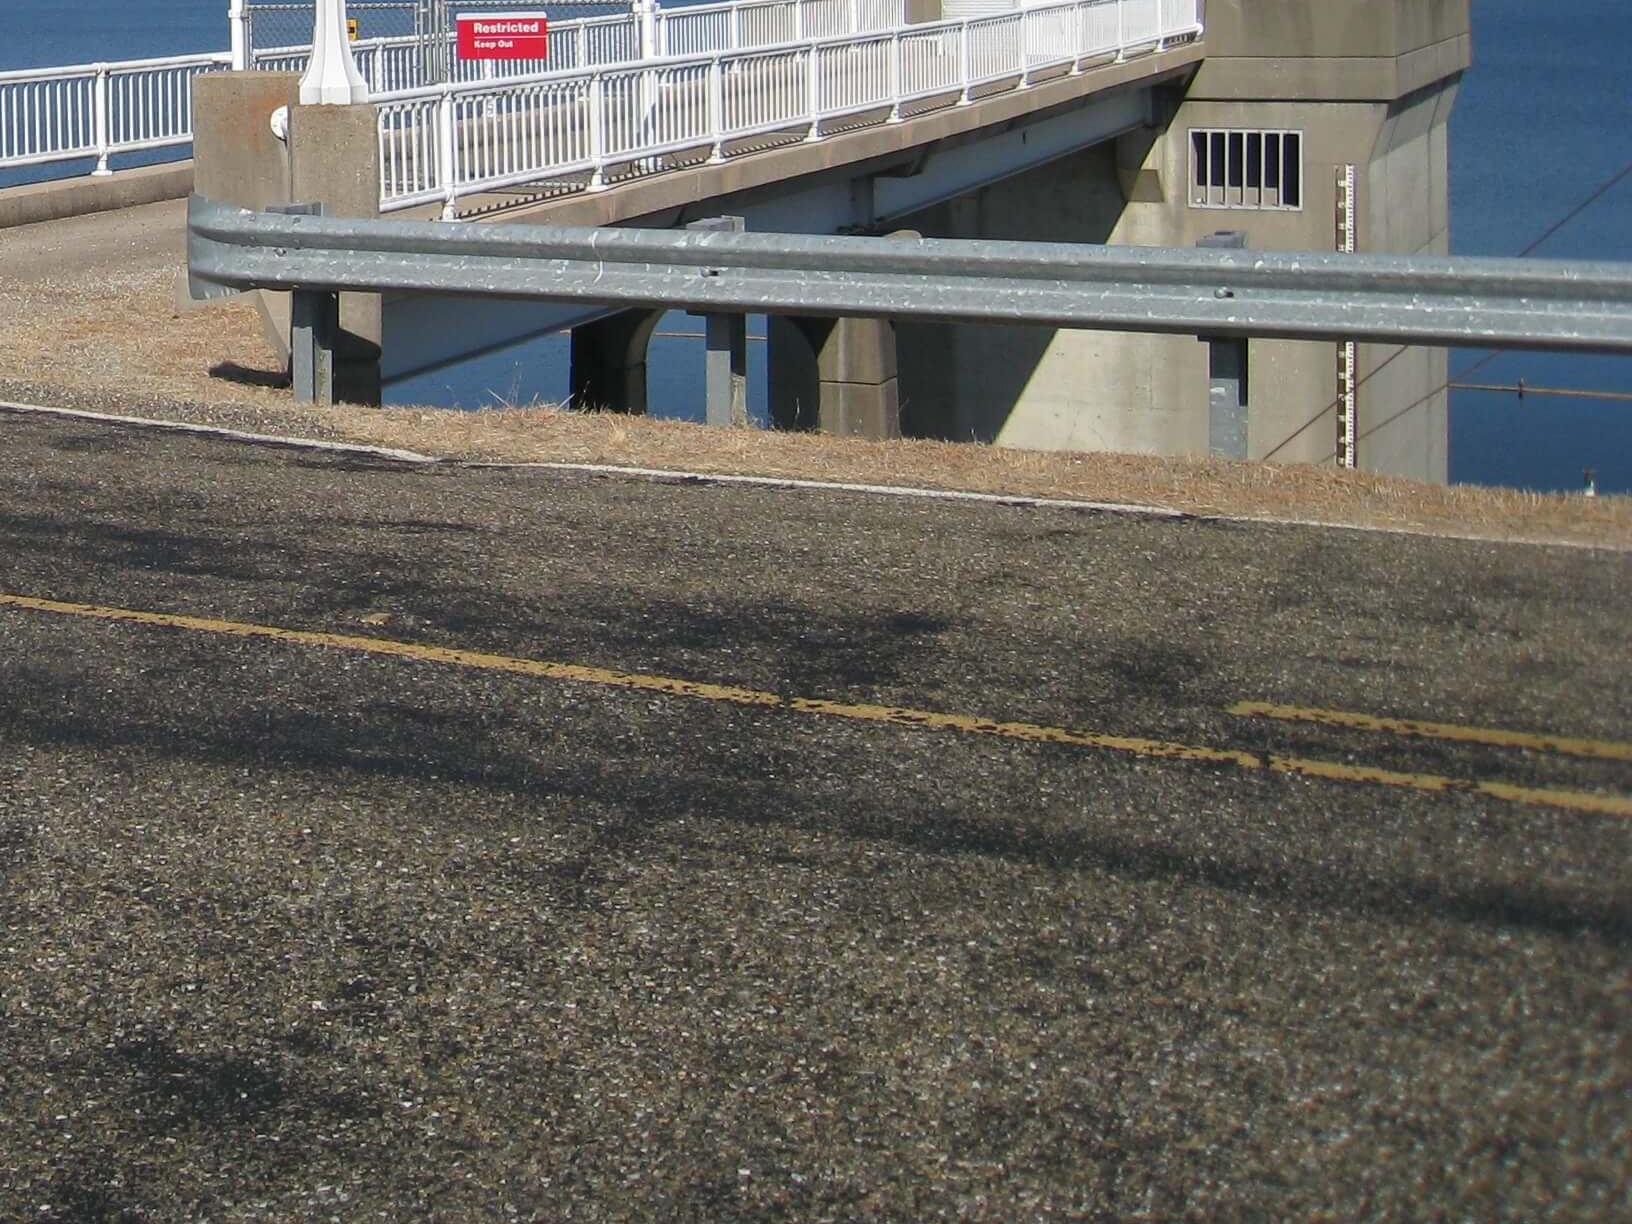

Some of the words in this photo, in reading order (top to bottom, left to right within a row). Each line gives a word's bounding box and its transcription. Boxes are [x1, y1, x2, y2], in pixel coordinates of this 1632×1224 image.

[473, 21, 539, 33] Restricted
[473, 39, 496, 49] Keep
[497, 39, 513, 48] Out
